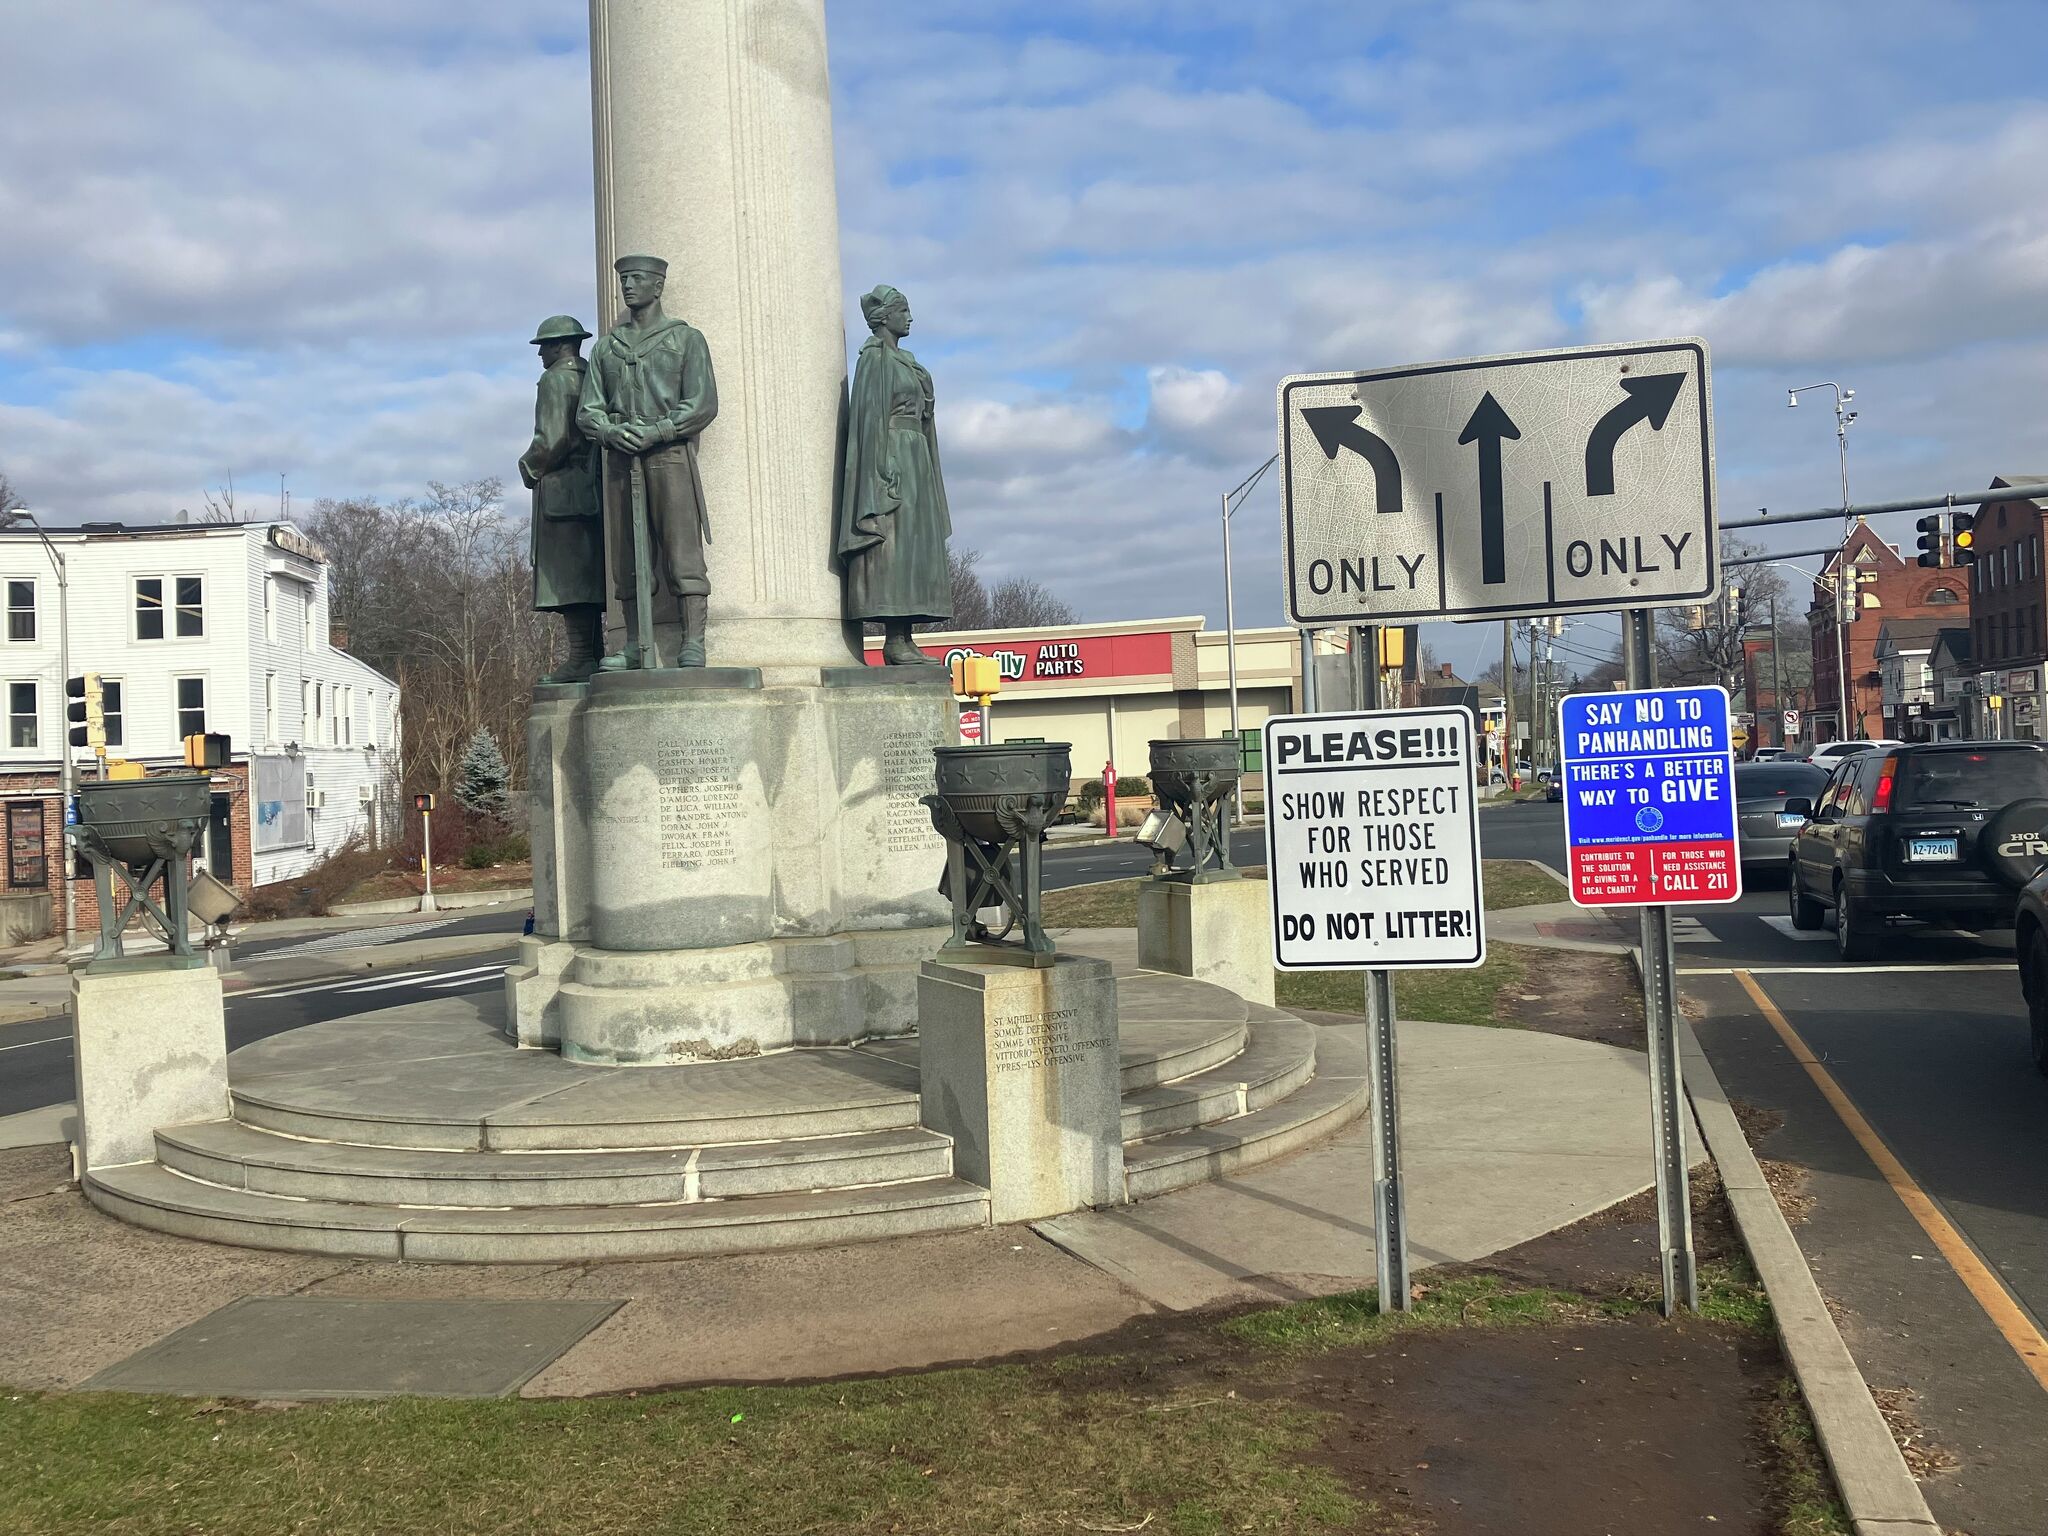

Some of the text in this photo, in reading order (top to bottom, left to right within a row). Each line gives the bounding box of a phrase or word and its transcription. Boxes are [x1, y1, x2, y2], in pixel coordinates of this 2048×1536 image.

[1566, 532, 1692, 578] ONLY
[1309, 554, 1425, 594] ONLY
[1039, 644, 1078, 659] AUTO
[1036, 660, 1084, 676] PARTS
[1586, 698, 1702, 726] SAY NO TO
[1277, 726, 1458, 764] PLEASE!!!
[1578, 726, 1712, 754] PANHANDLING
[1571, 759, 1724, 781] THERE'S A BETTER
[1580, 778, 1720, 806] WAY TO GIVE
[1282, 786, 1458, 820] SHOW RESPECT
[1308, 823, 1436, 854] FOR THOSE
[1581, 852, 1635, 862] CONTRIBUTE TO
[1662, 850, 1726, 860] FOR THOSE WHO
[1300, 858, 1449, 888] WHO SERVED
[1582, 864, 1632, 872] THE SOLUTION
[1664, 862, 1726, 871] NEED ASSISTANCE
[1594, 874, 1616, 884] GIVING
[1620, 874, 1630, 882] TO
[1634, 874, 1638, 882] A
[1664, 872, 1728, 891] CALL 211
[1582, 886, 1636, 895] LOCAL CHARITY
[1283, 910, 1472, 941] DO NOT LITTER!
[1037, 1008, 1078, 1022] OFFENSIVE
[1027, 1033, 1070, 1046] OFFENSIVE
[1072, 1038, 1112, 1052] OFFENSIVE
[1044, 1053, 1085, 1066] OFFENSIVE
